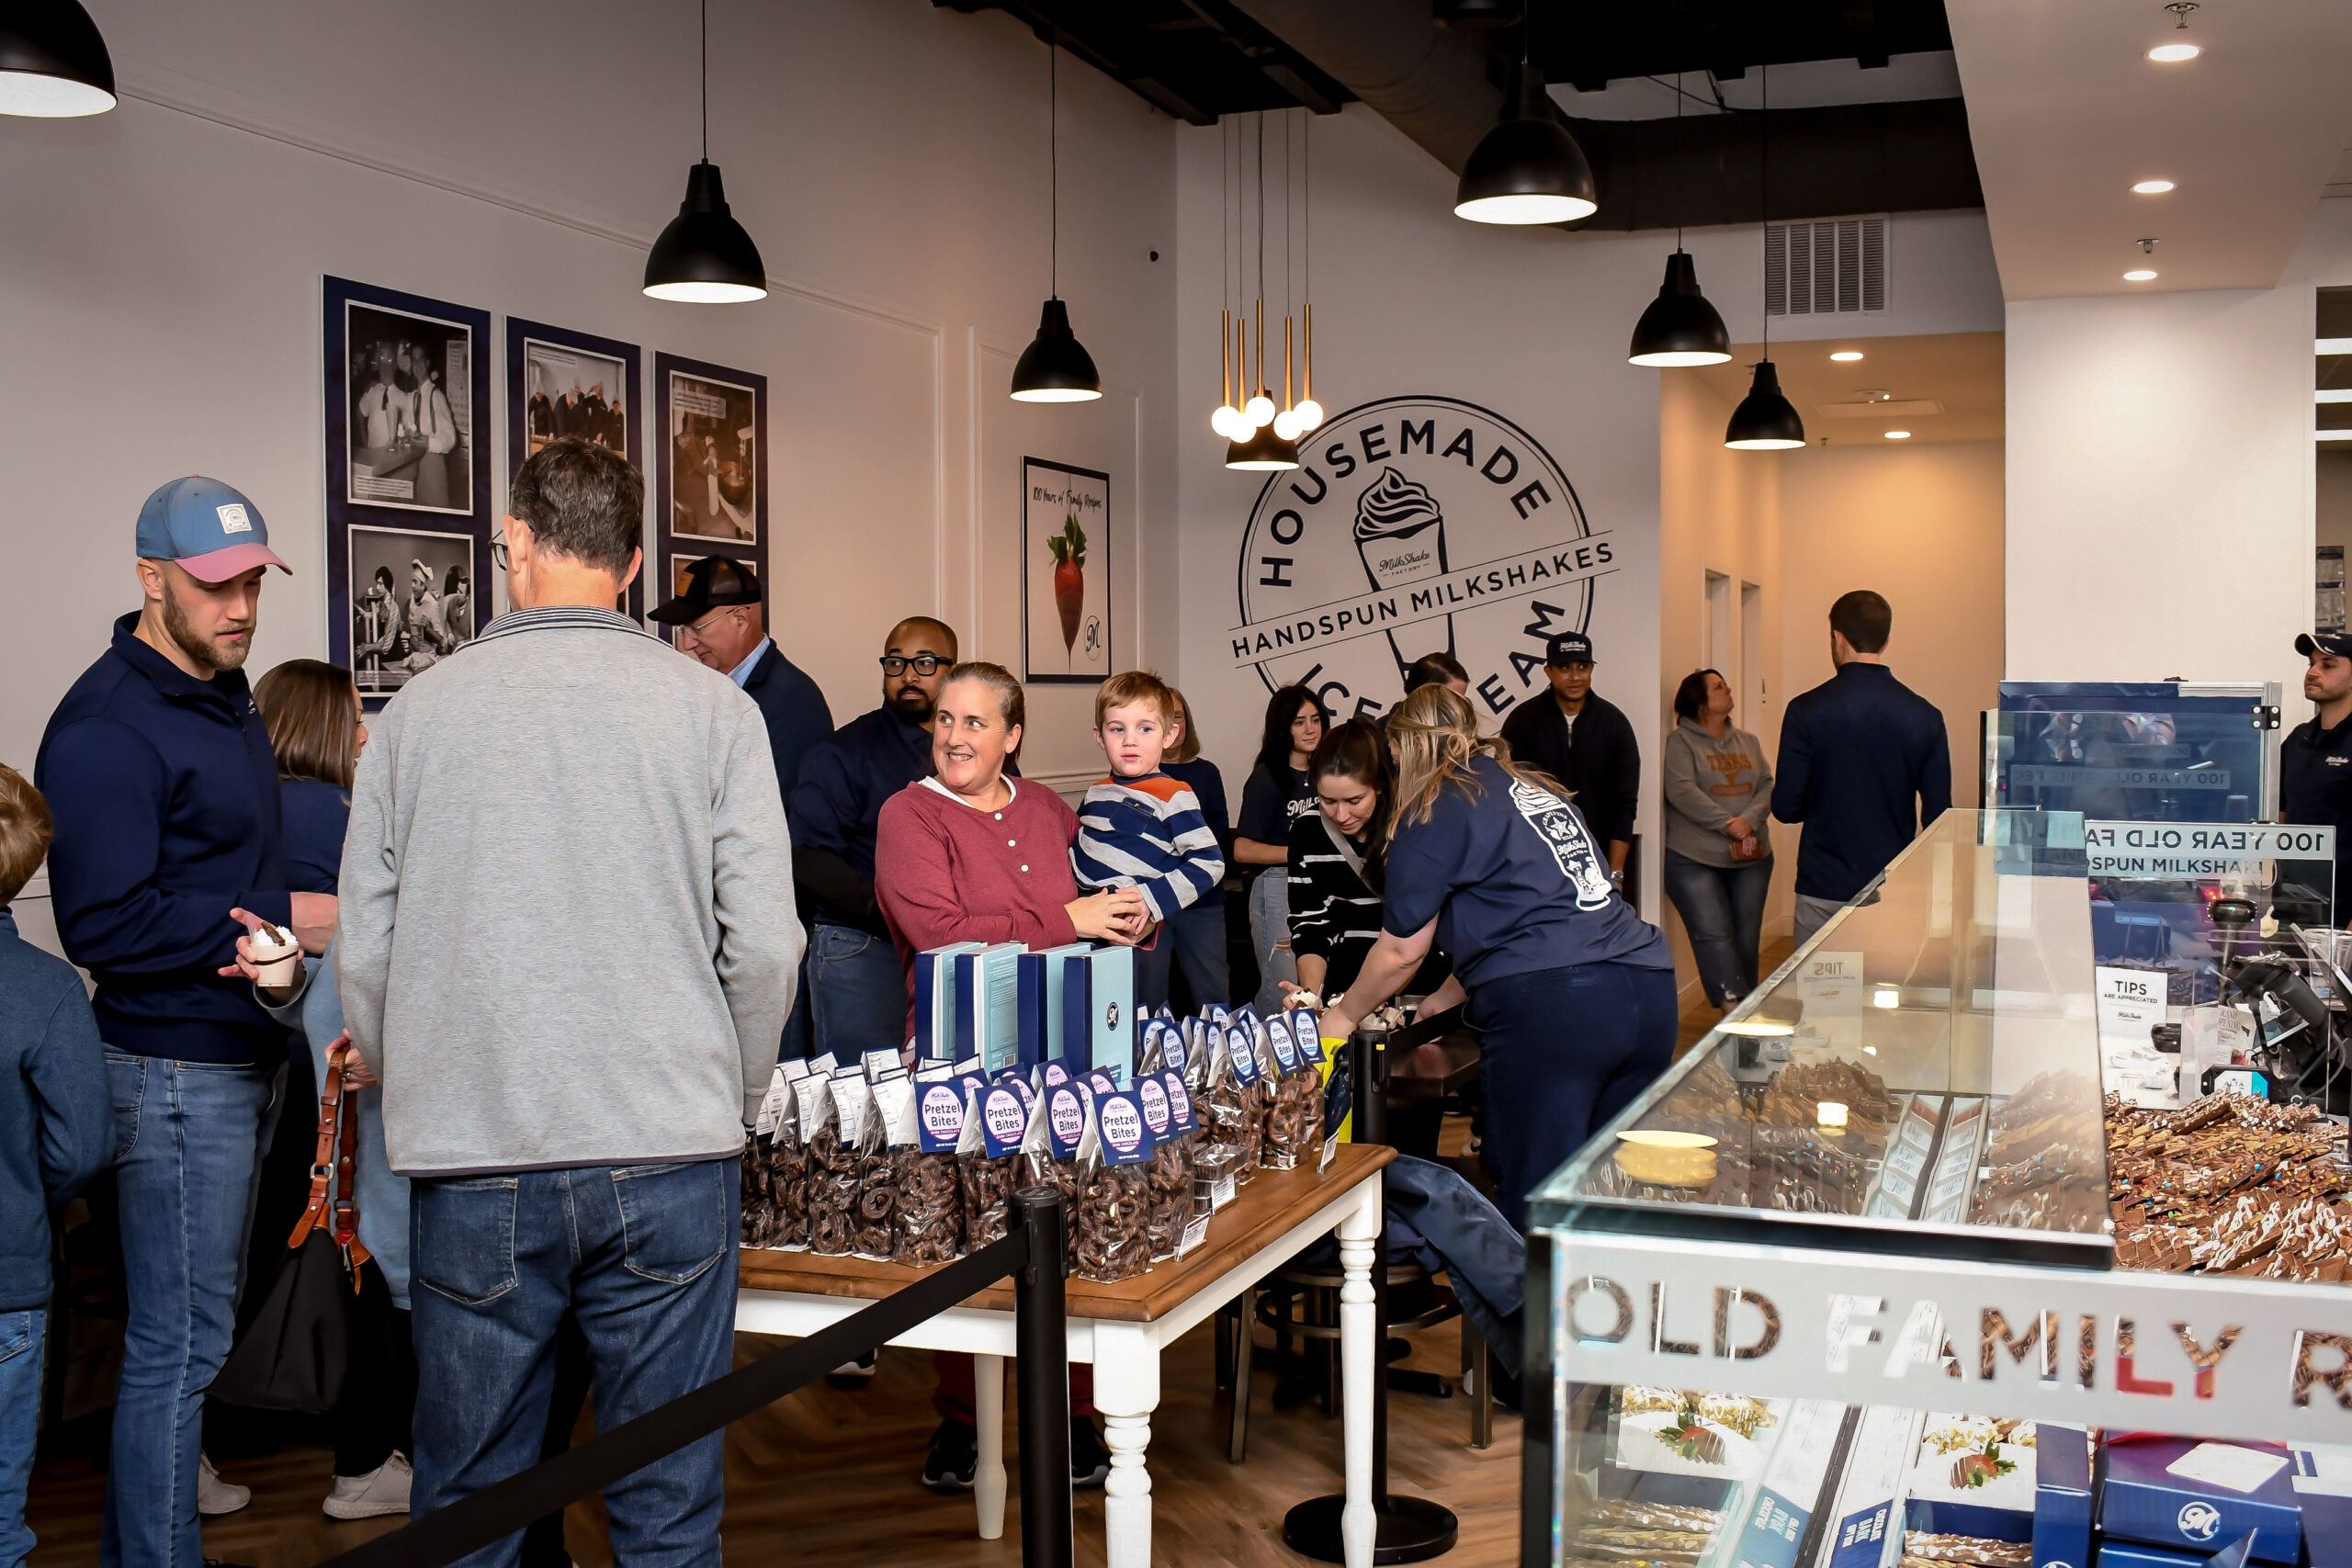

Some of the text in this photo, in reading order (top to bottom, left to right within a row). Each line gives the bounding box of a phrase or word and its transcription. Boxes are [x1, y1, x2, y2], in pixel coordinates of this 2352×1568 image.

[1260, 419, 1552, 587] HOUSEMADE
[1379, 549, 1430, 571] MilkShake
[1232, 542, 1614, 658] HANDSPUN MILKSHAKES
[1476, 600, 1566, 716] EAM
[1706, 752, 1752, 773] TEXAS
[2115, 980, 2147, 996] TIPS
[2118, 995, 2158, 1004] APPRECIATED
[1297, 1026, 1316, 1036] Pretzel
[1273, 1035, 1291, 1046] Pretzel
[1301, 1036, 1316, 1045] Bites
[1165, 1043, 1182, 1055] Pretzel
[1231, 1043, 1247, 1055] Pretzel
[1278, 1046, 1292, 1056] Bites
[1170, 1055, 1182, 1066] Bites
[1237, 1055, 1250, 1066] Bites
[924, 1102, 961, 1115] Pretzel
[1143, 1096, 1166, 1109] Pretzel
[988, 1104, 1022, 1120] Pretzel
[1053, 1106, 1080, 1119] Pretzel
[1148, 1108, 1166, 1121] Bites
[931, 1116, 957, 1127] Bites
[995, 1119, 1020, 1131] Bites
[1058, 1119, 1079, 1132] Bites
[1103, 1112, 1138, 1127] Pretzel
[1111, 1127, 1136, 1139] Bites
[1566, 1273, 2352, 1408] OLD FAMILY R
[1854, 1517, 1874, 1544] BARK
